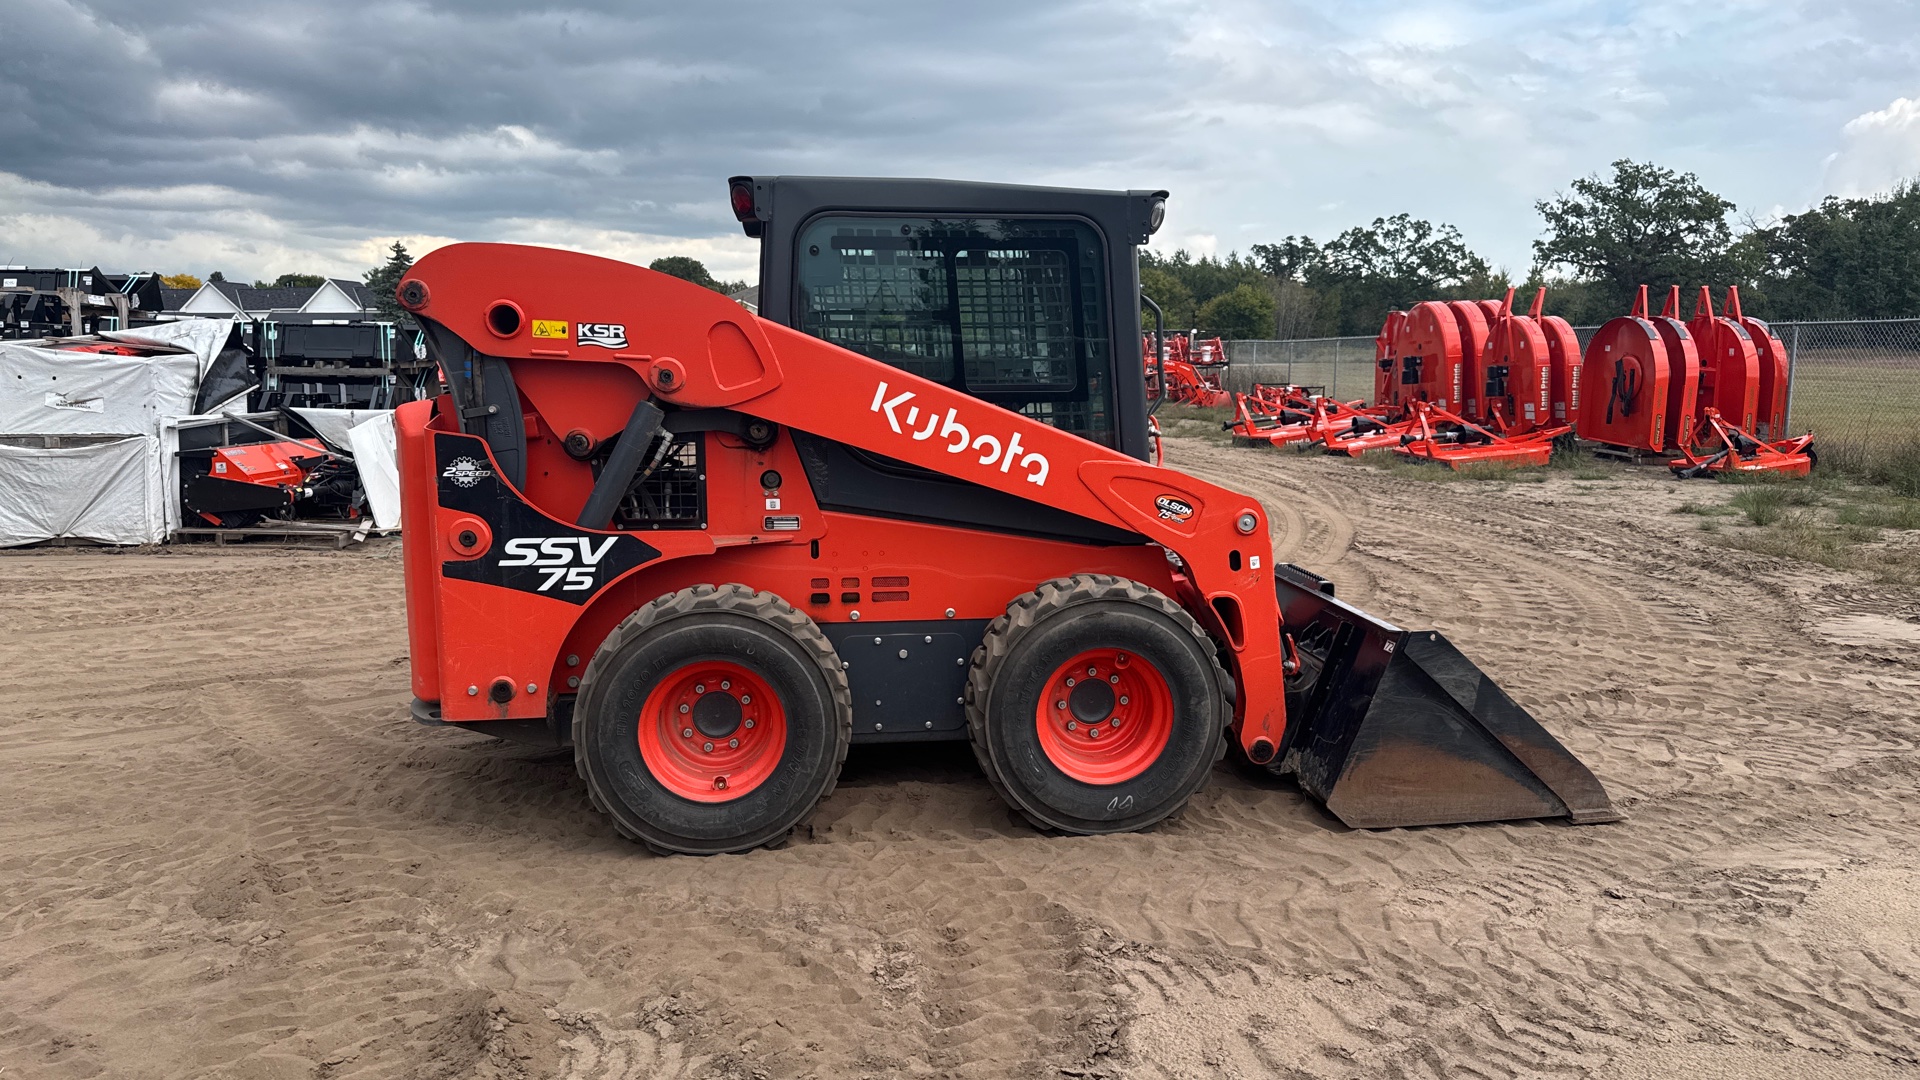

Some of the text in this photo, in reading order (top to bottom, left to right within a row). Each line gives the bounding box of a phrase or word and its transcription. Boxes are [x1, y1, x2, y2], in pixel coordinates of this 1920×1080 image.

[577, 323, 625, 338] KSR
[1453, 363, 1461, 384] Pride
[1540, 366, 1549, 411] Land Pride
[1571, 366, 1581, 410] Land Pride
[870, 381, 1050, 487] Kubota
[1157, 497, 1192, 516] OLSON
[1158, 509, 1172, 519] 75
[498, 537, 619, 566] SSV
[537, 567, 596, 592] 75
[1385, 641, 1395, 653] 72
